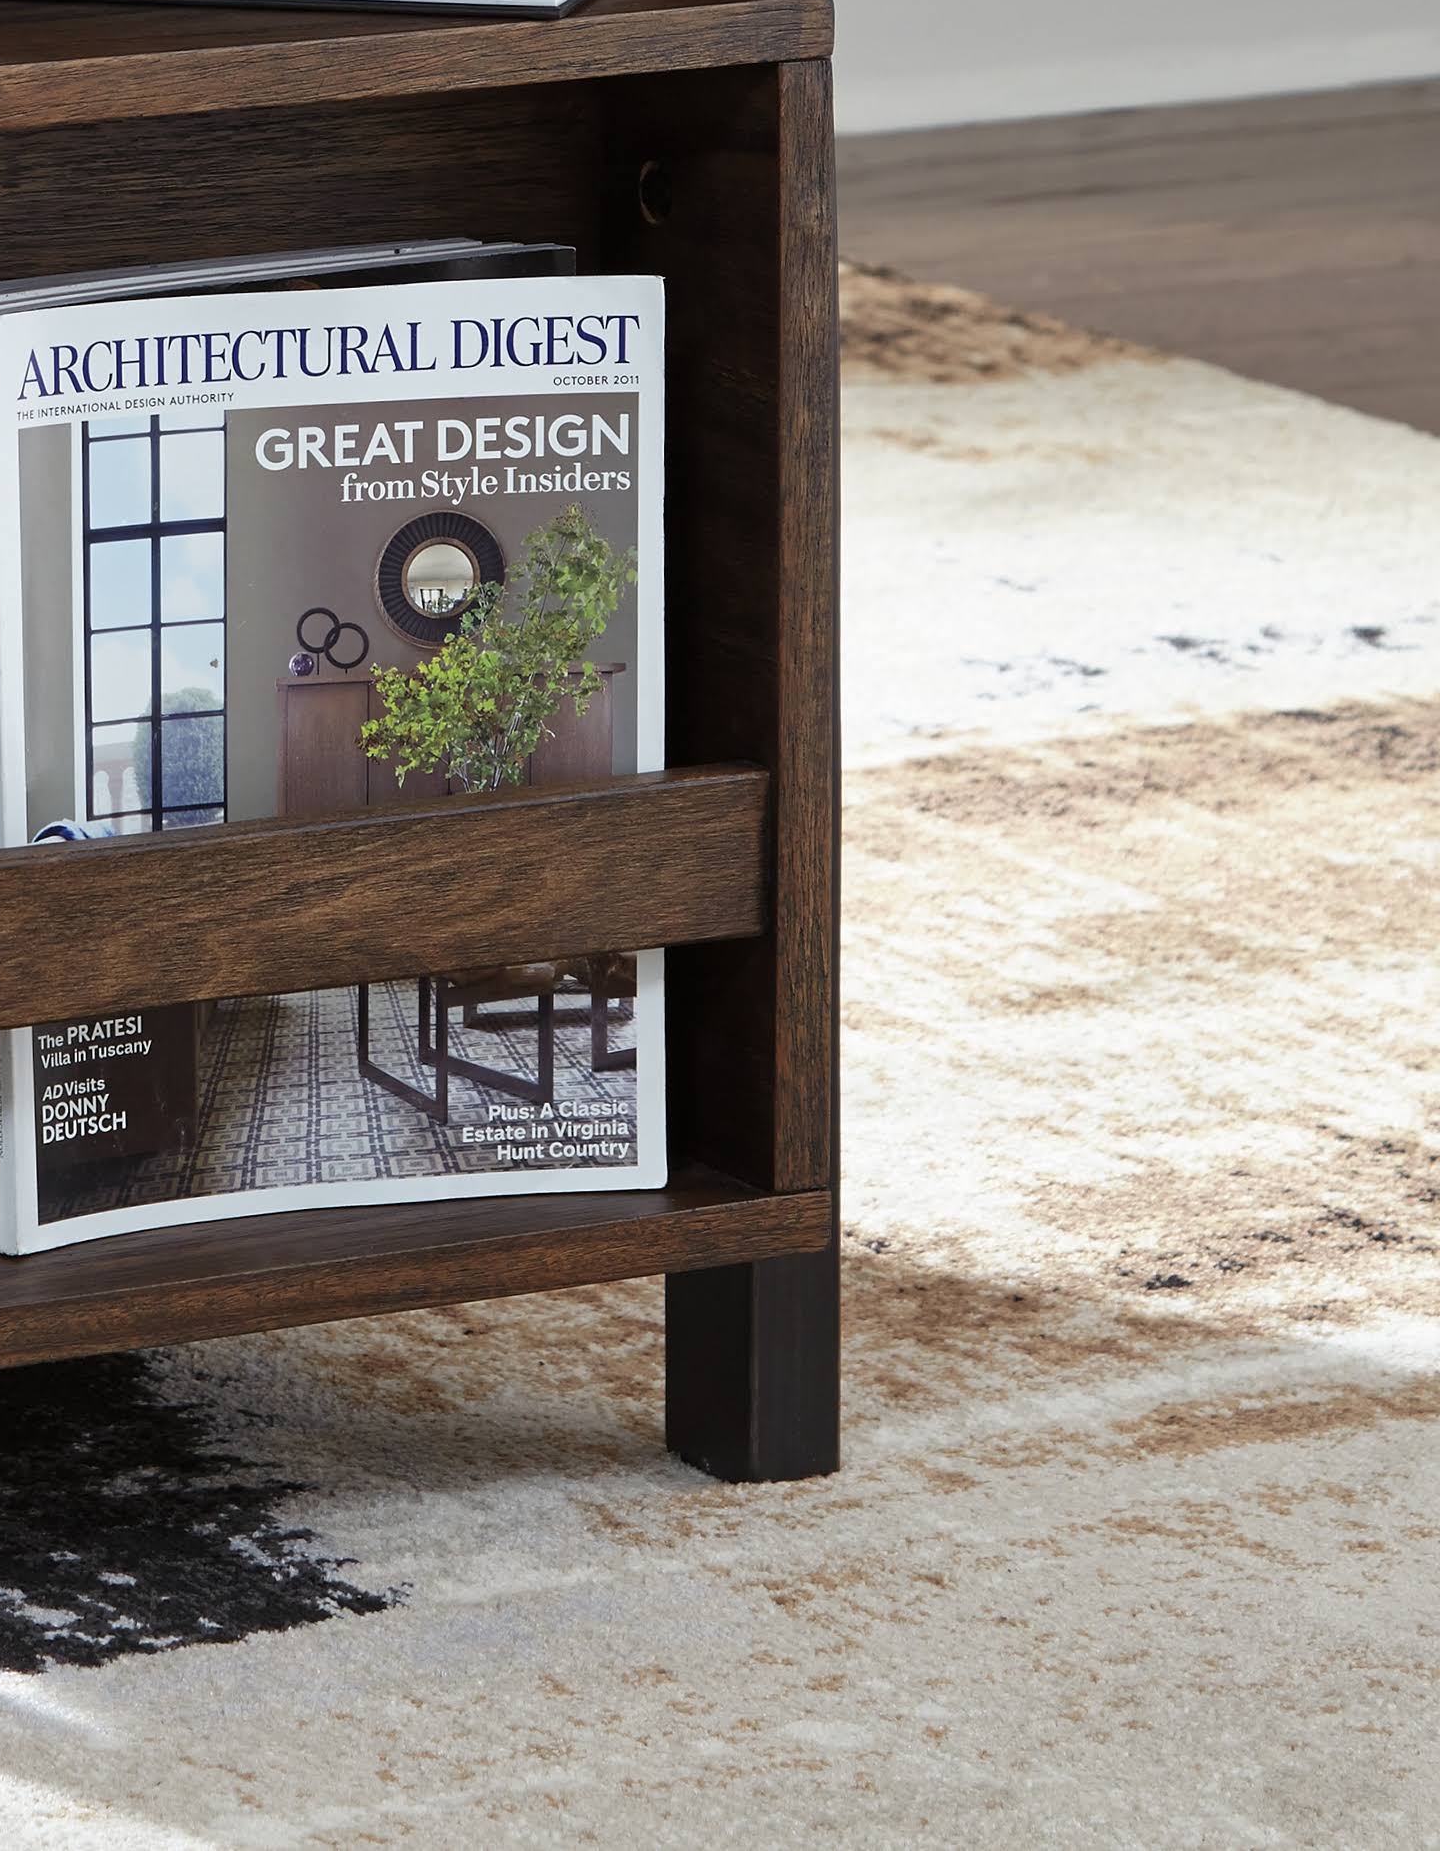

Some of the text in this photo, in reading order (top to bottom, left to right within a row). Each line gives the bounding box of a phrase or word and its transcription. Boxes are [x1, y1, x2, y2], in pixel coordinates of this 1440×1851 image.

[17, 322, 437, 400] ARCHITECTURAL
[450, 315, 640, 369] DIGEST
[553, 375, 640, 387] OCTOBER 2011
[17, 392, 235, 421] THE INTERNATIONAL DESIGN AUTHORITY
[255, 413, 630, 471] GREAT DESIGN
[340, 463, 631, 505] from Style Insiders
[38, 1015, 142, 1050] The PRATESI
[41, 1039, 152, 1069] Villa in Tuscany
[42, 1078, 105, 1101] AD Visits
[42, 1093, 109, 1123] DONNY
[489, 1099, 628, 1121] Plus: A Classic
[43, 1110, 126, 1144] DEUTSCH
[462, 1120, 629, 1143] Estate in Virginia
[497, 1140, 629, 1161] Hunt Country
